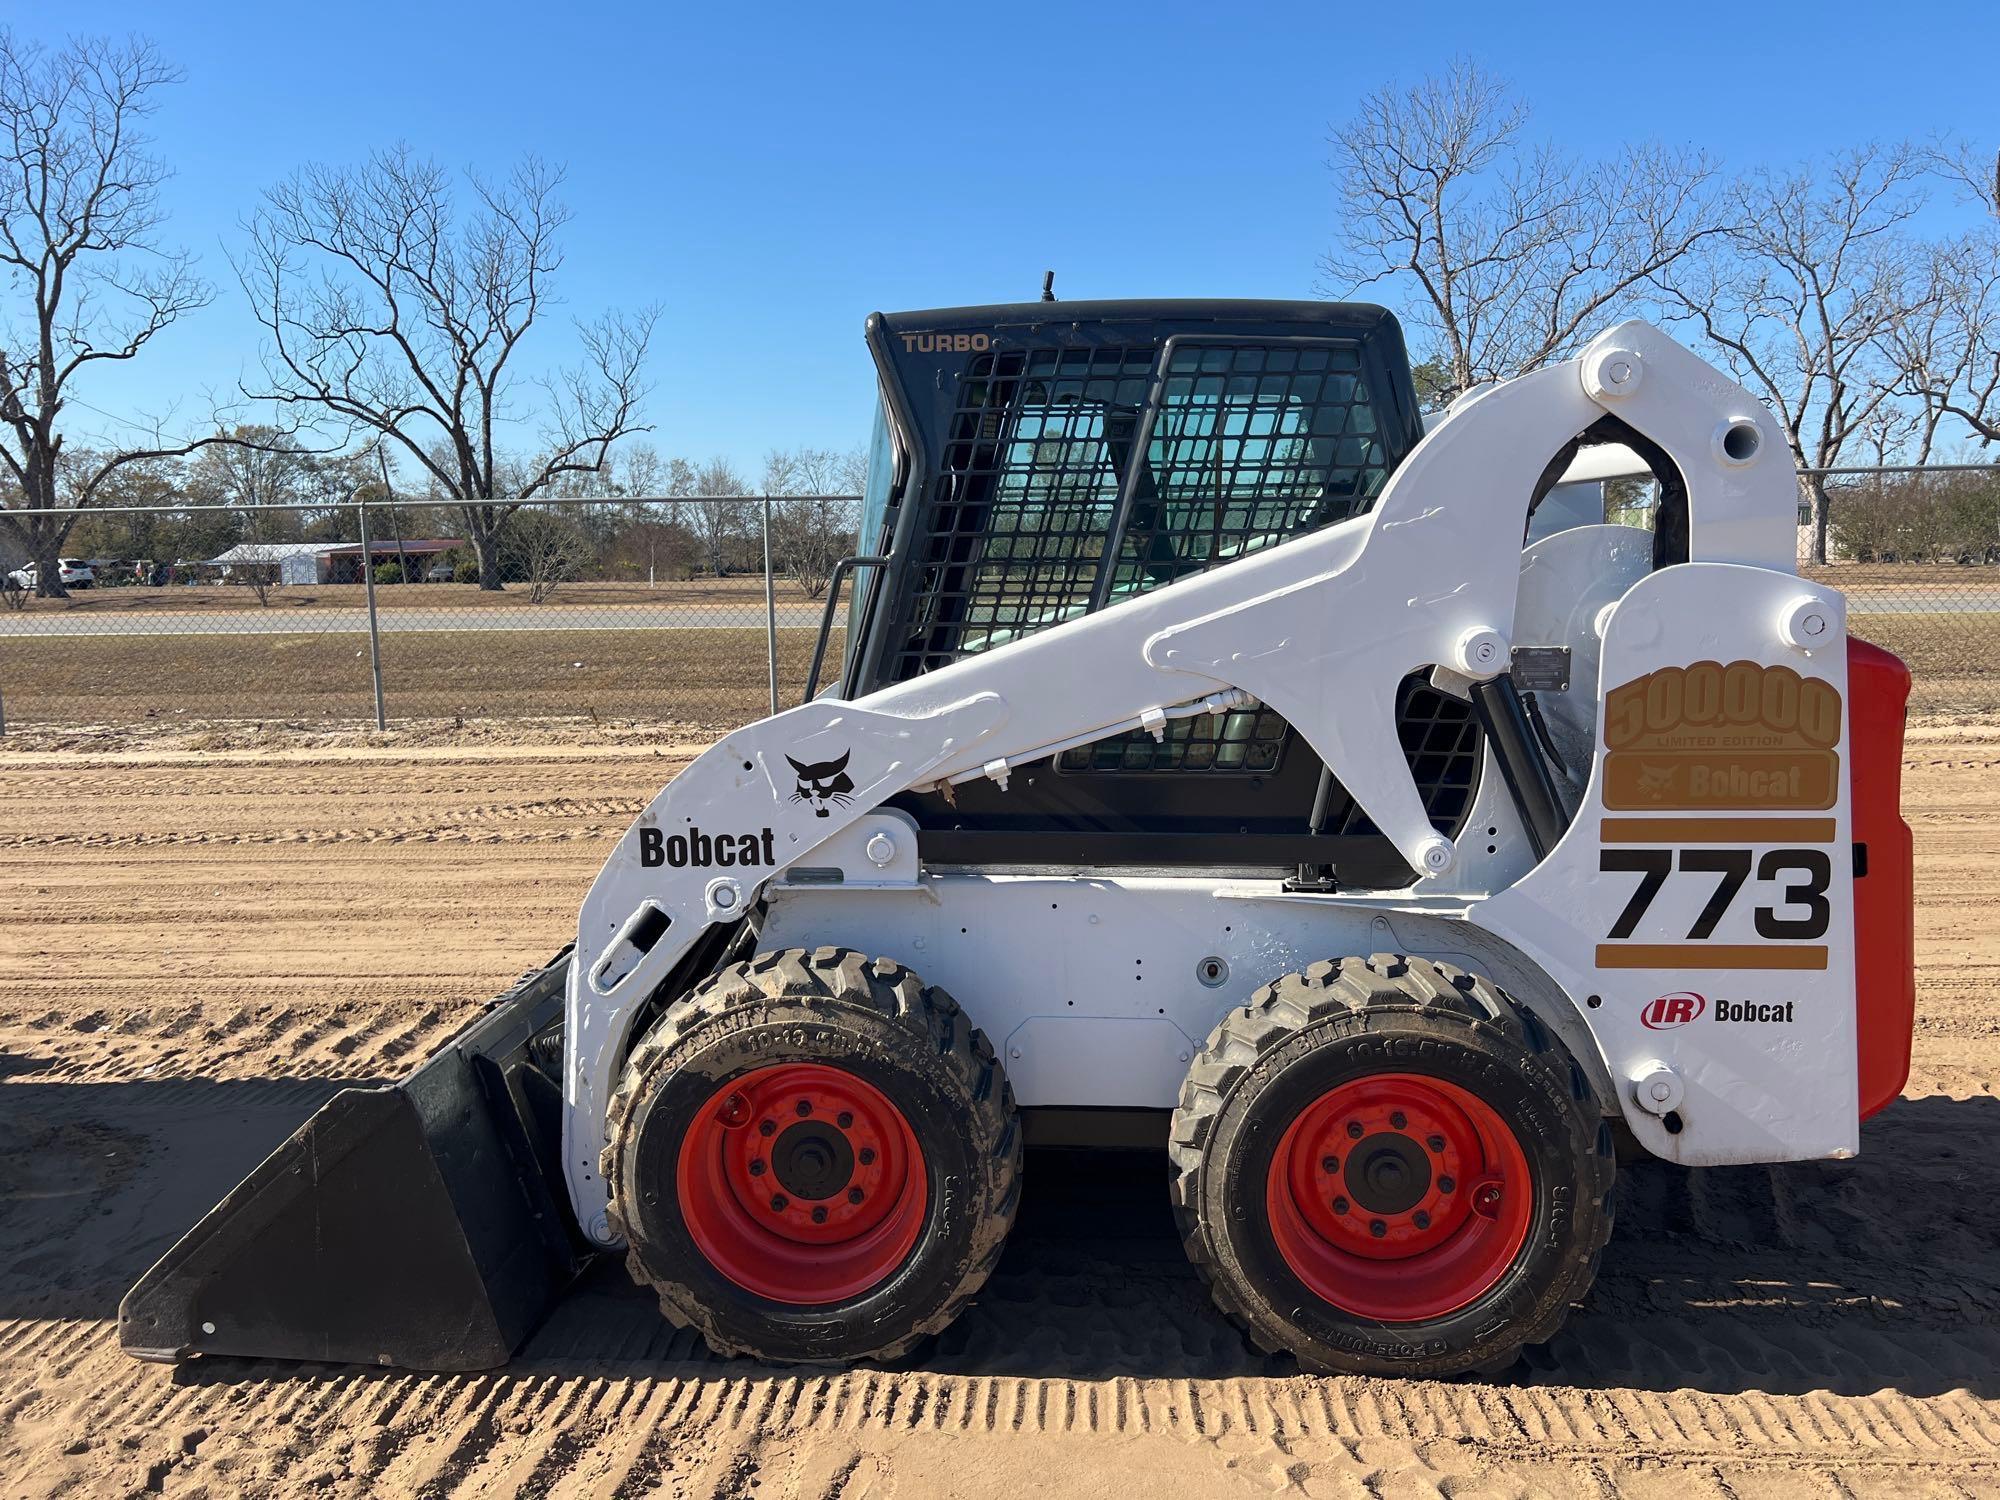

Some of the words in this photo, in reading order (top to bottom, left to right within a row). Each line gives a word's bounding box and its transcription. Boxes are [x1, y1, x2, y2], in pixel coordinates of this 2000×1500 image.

[902, 334, 989, 353] TURBO
[1656, 736, 1717, 748] LIMITED
[1722, 736, 1784, 747] EDITION
[1689, 764, 1801, 799] Bobcat
[640, 827, 775, 868] Bobcat
[1600, 849, 1831, 940] 773
[1715, 999, 1794, 1023] Bobcat
